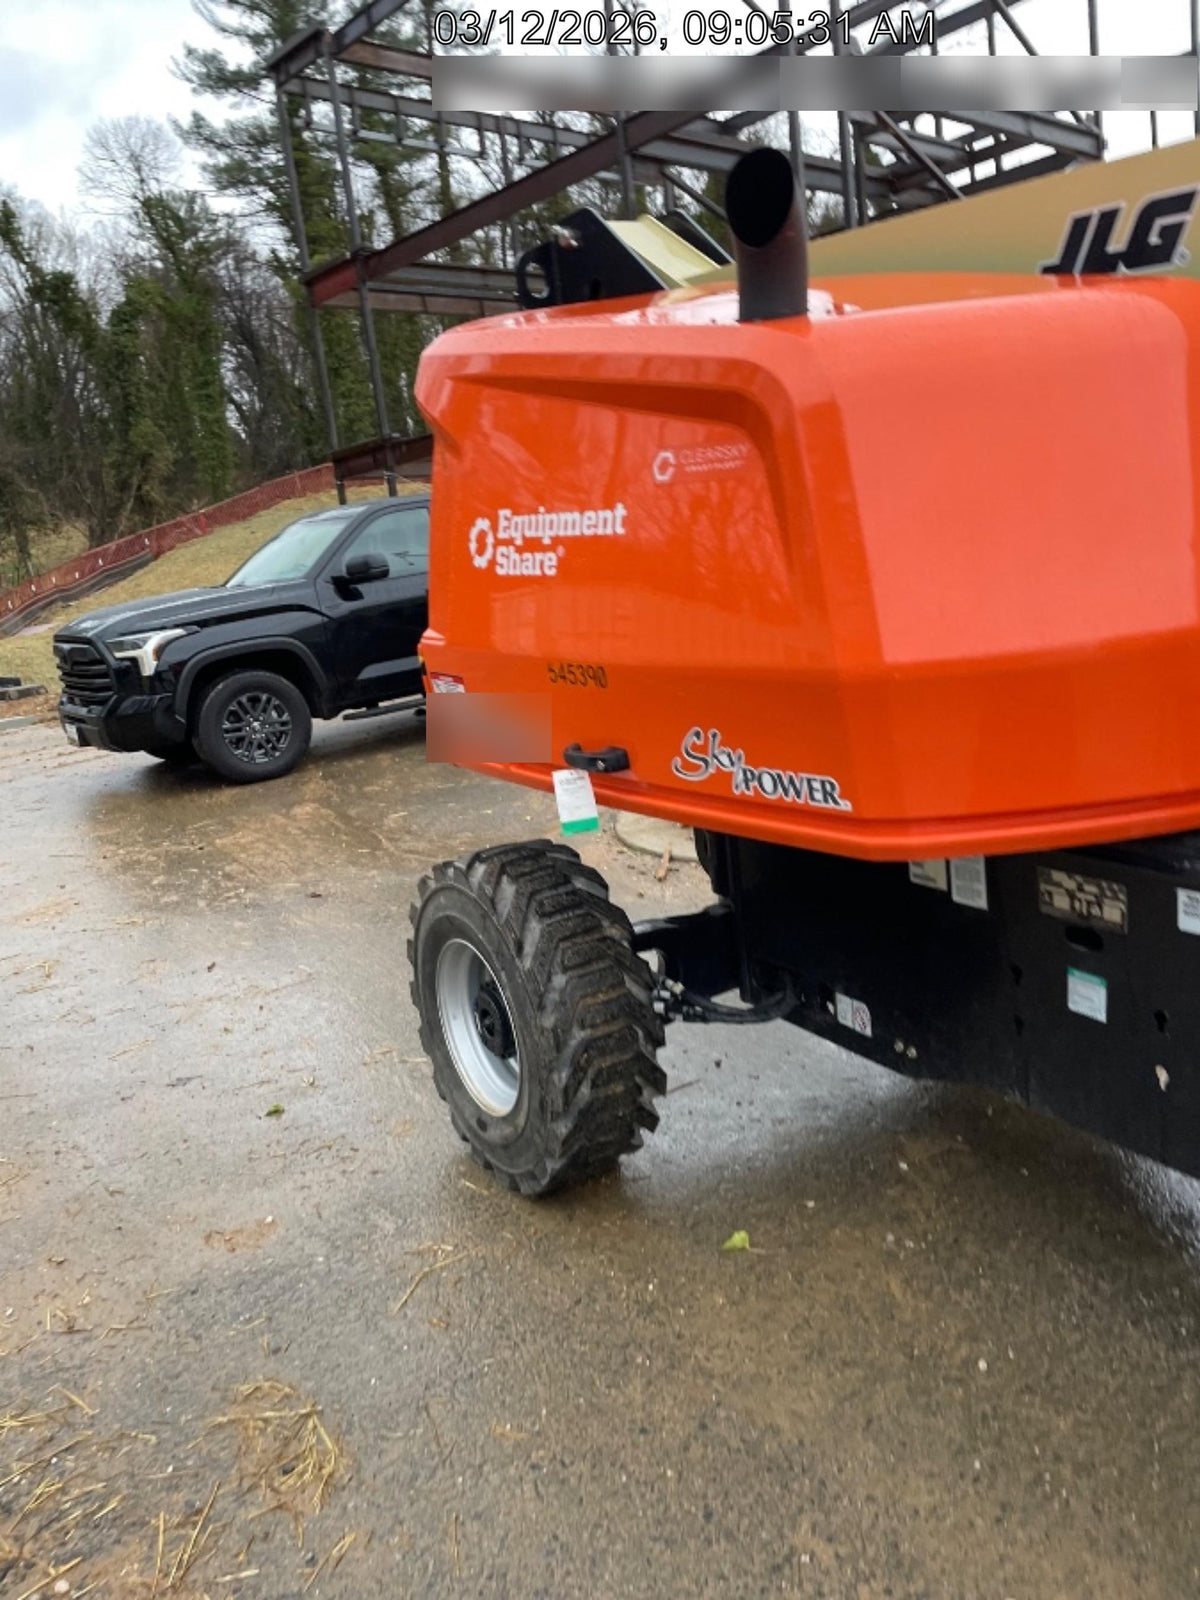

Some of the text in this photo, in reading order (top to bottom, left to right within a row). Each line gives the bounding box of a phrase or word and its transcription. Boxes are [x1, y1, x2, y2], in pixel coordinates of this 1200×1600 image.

[1037, 184, 1200, 275] JLG
[497, 502, 627, 545] Equipment
[547, 662, 608, 689] 545390
